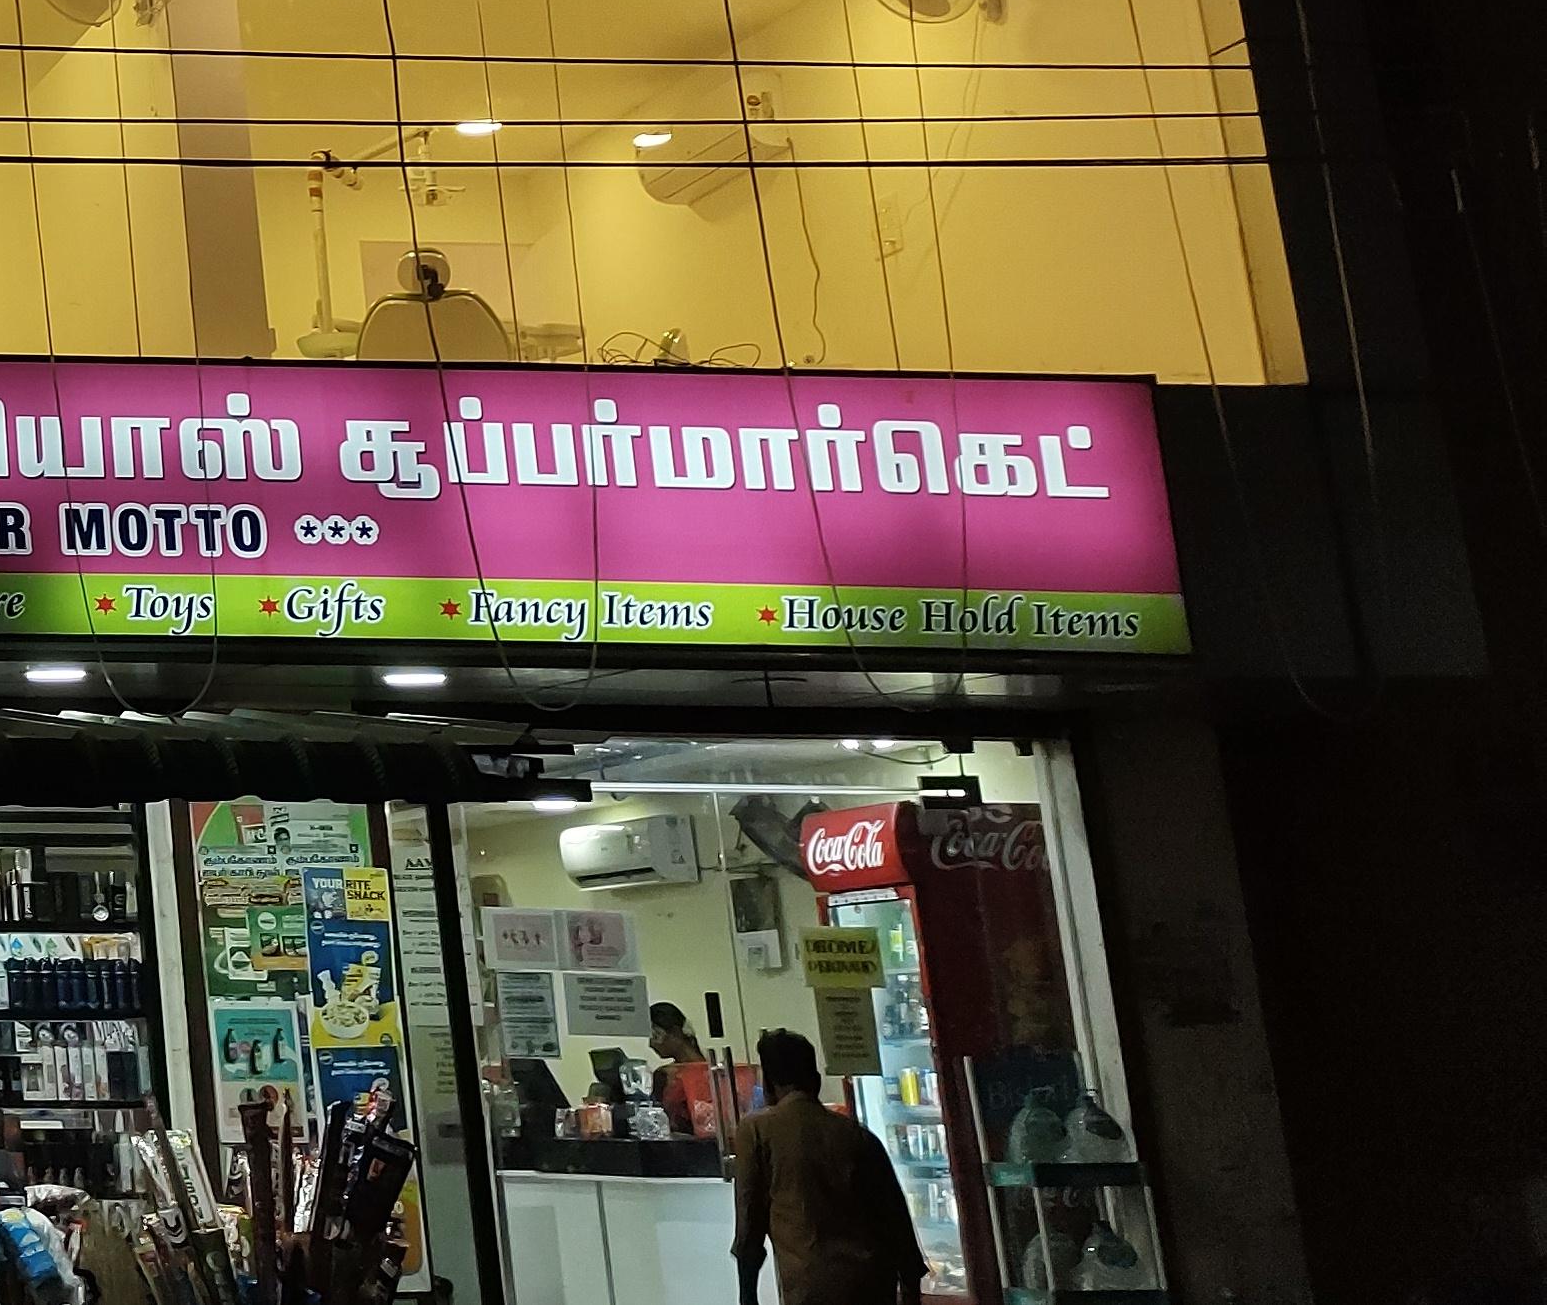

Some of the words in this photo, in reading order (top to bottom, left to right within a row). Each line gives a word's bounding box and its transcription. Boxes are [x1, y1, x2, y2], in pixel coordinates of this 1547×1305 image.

[339, 395, 1110, 501] சூப்பர்மார்கெட்
[61, 502, 267, 559] MOTTO
[124, 584, 215, 635] Toys
[284, 581, 384, 638] Gifts
[469, 588, 587, 641] Fancy
[601, 592, 713, 631] Items
[782, 595, 907, 633] House
[918, 593, 1021, 638] Hold
[1029, 601, 1141, 640] Items
[311, 877, 343, 889] YOUR
